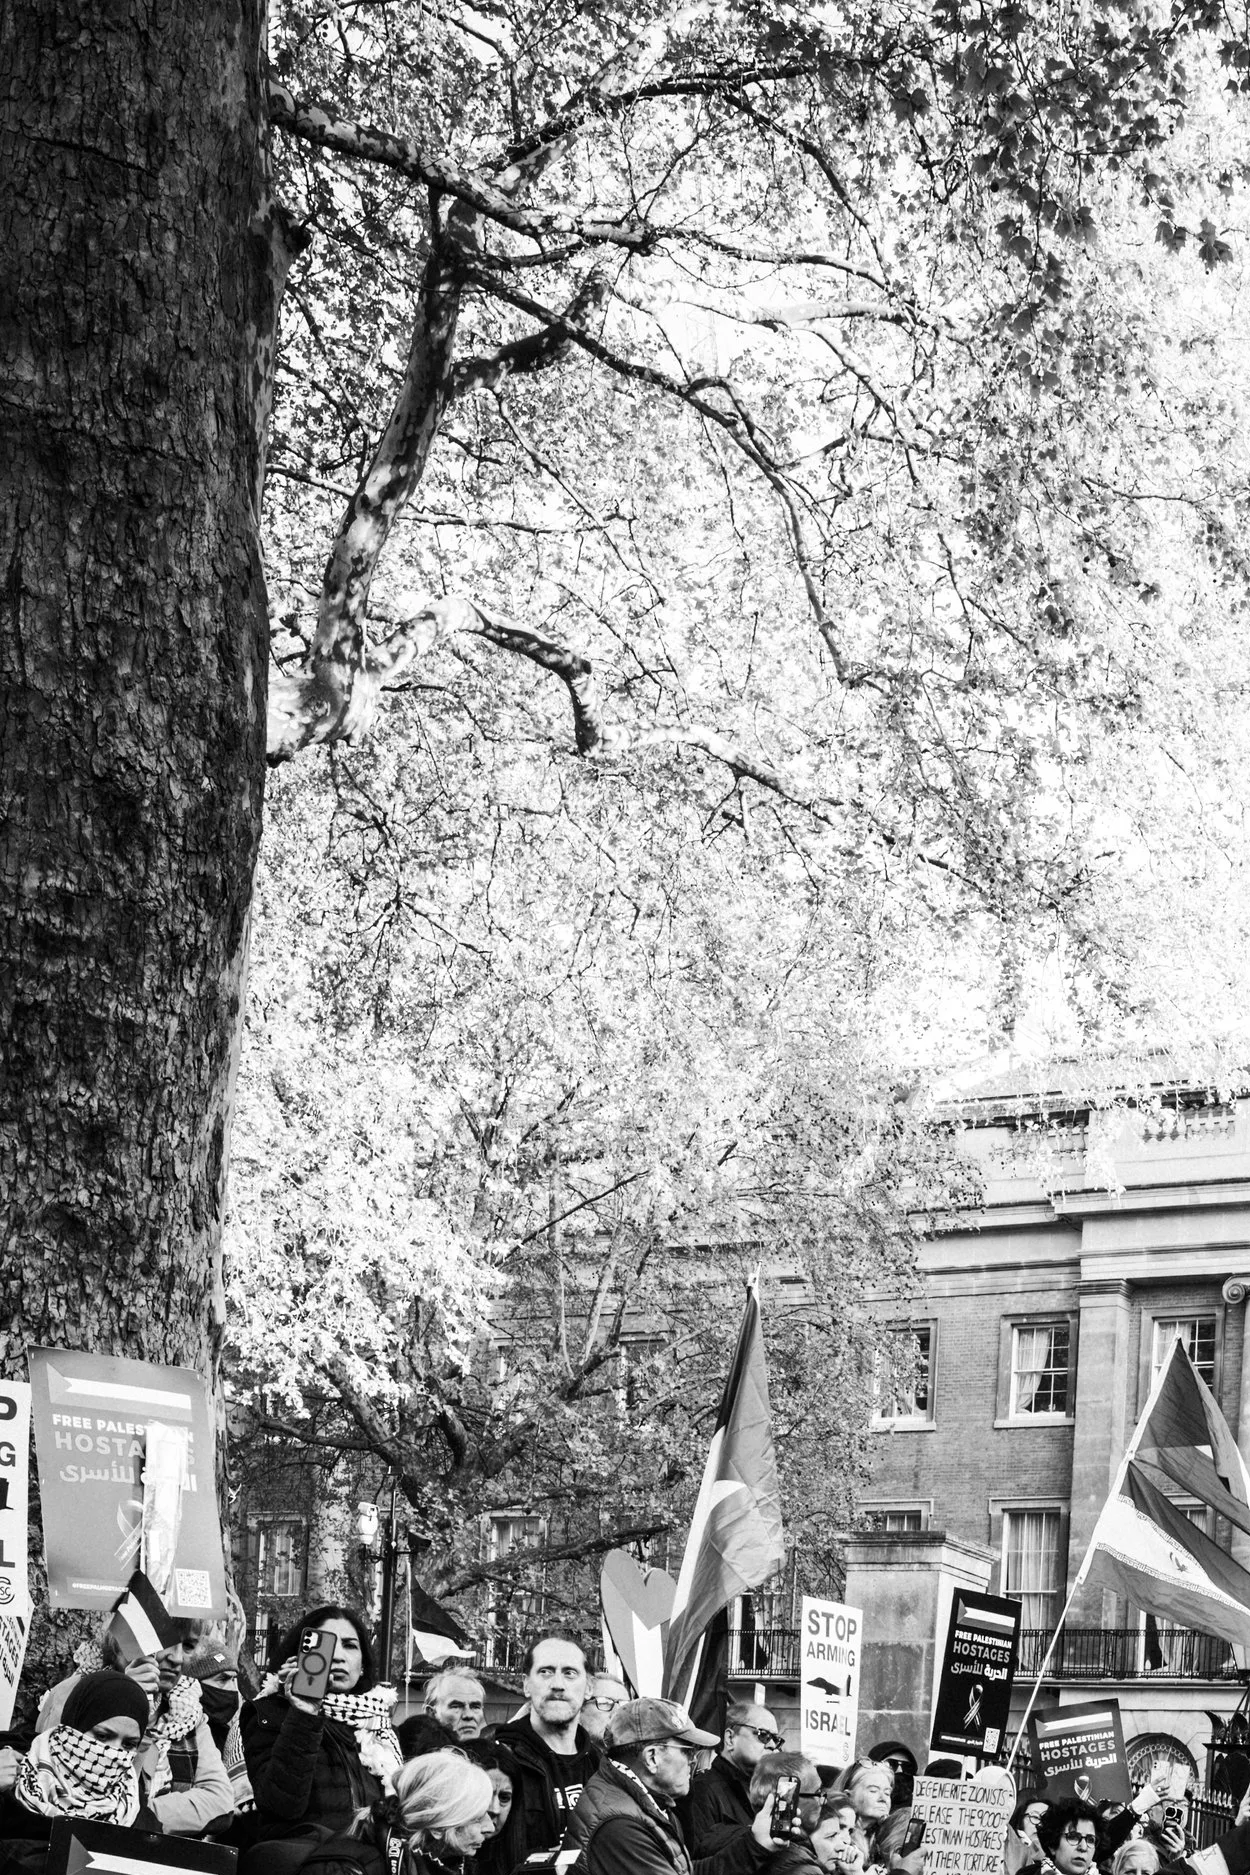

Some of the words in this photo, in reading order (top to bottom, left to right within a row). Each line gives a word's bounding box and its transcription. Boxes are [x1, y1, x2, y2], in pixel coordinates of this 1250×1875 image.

[52, 1414, 92, 1430] FREE
[807, 1609, 857, 1642] STOP
[955, 1630, 972, 1642] FREE
[972, 1633, 1012, 1649] PALESTINIAN
[806, 1641, 855, 1667] ARMING
[953, 1641, 1011, 1664] HOSTAGES
[1039, 1740, 1060, 1750] FREE
[1061, 1731, 1114, 1746] PALESTINIAN
[1040, 1740, 1116, 1762] HOSTAGES
[915, 1780, 968, 1802] DEGENERATE
[968, 1785, 1008, 1806] ZIONISTS
[965, 1829, 1003, 1850] HOSTAGES
[936, 1850, 961, 1869] THEIR
[963, 1853, 1000, 1872] TORTURE
